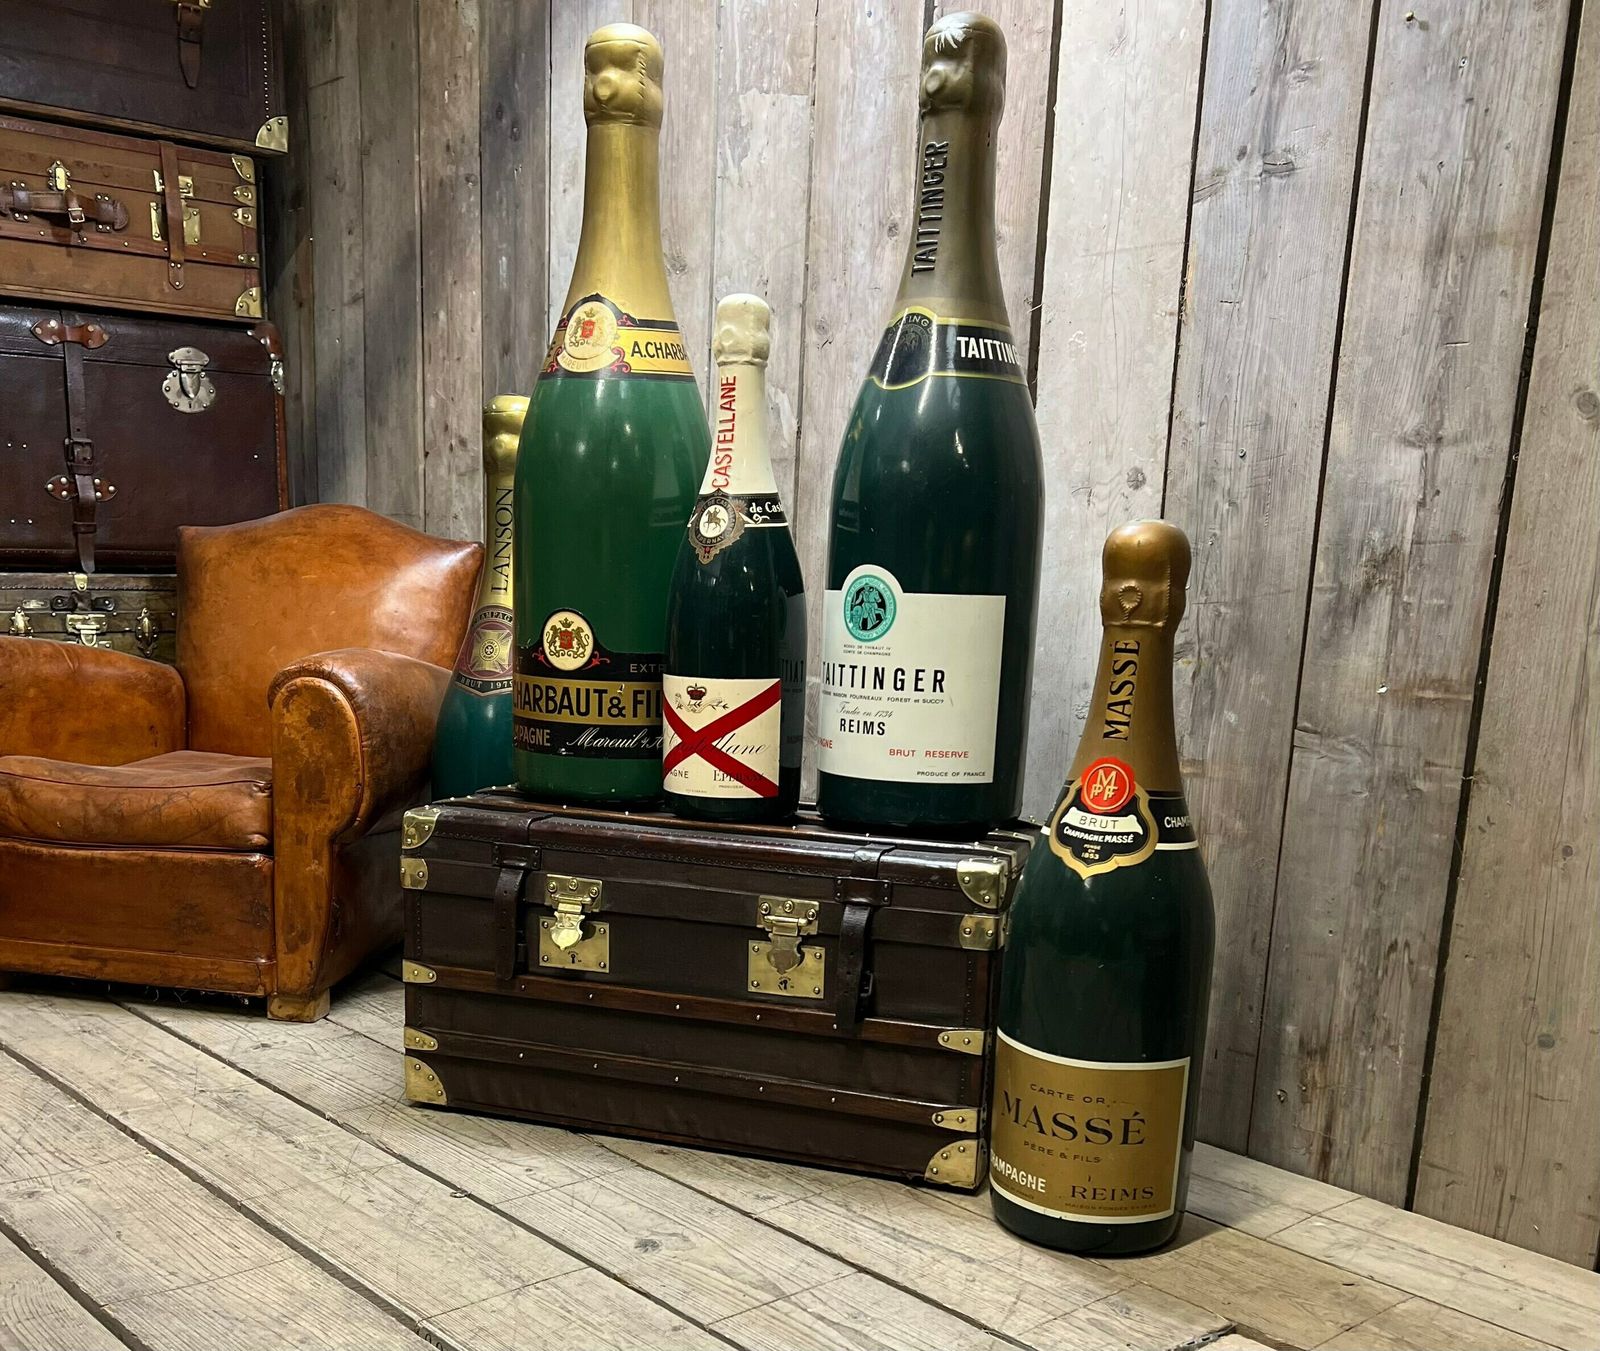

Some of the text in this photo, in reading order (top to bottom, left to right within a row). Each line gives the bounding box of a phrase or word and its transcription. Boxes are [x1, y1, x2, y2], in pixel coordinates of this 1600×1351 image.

[911, 140, 950, 278] TAITTINGER
[711, 375, 737, 489] CASTELLANE
[749, 502, 763, 514] de
[490, 487, 514, 592] LANSON
[461, 676, 483, 688] BRUT
[514, 681, 608, 717] HARBAUT
[840, 717, 886, 736] REIMS
[888, 748, 969, 759] BRUT RESERVE
[1079, 815, 1119, 830] BRUT
[1063, 825, 1135, 844] CHAMPAGNE MASSÉ
[1030, 1083, 1106, 1105] CARTE OR
[1001, 1089, 1147, 1145] MASSÉ
[1059, 1151, 1068, 1159] &
[1073, 1154, 1102, 1164] FILS
[1071, 1185, 1155, 1201] REIMS
